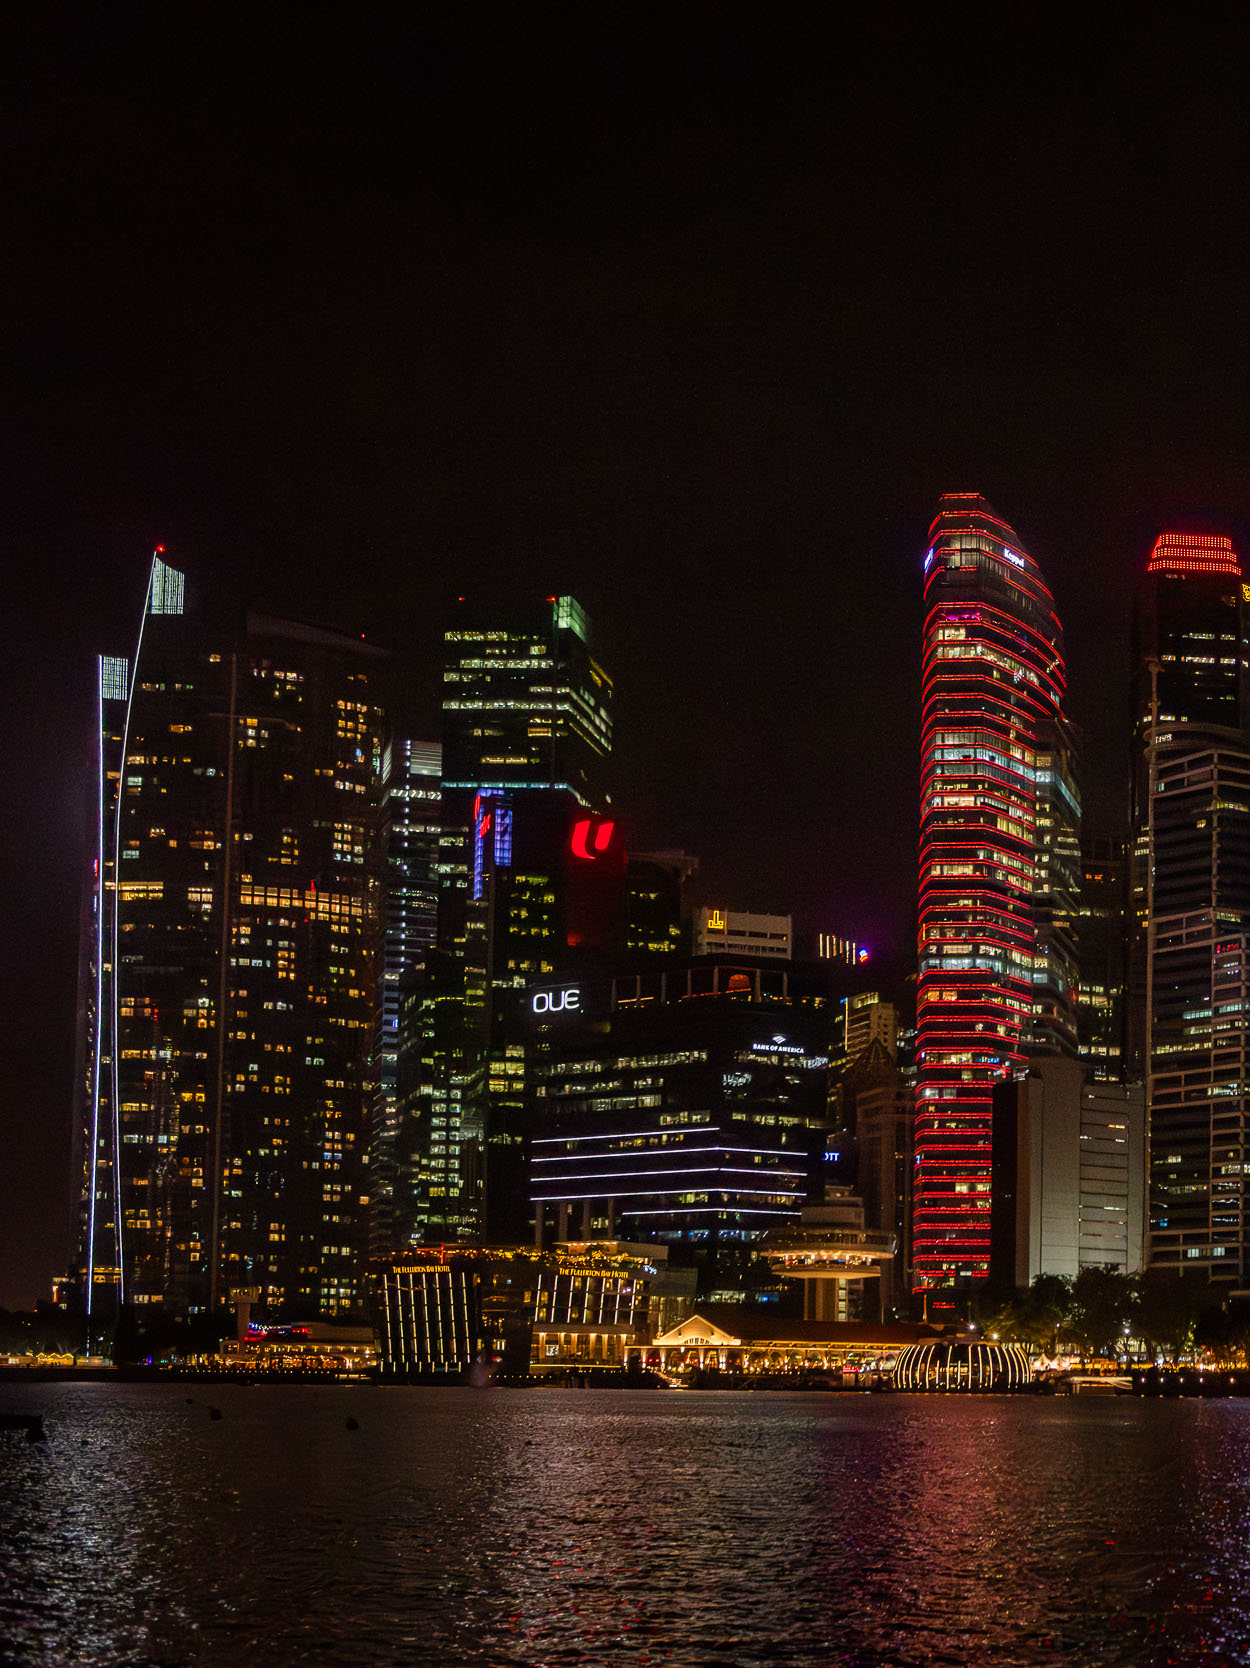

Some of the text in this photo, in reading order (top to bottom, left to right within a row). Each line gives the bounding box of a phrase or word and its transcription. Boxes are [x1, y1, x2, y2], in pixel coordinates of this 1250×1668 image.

[532, 989, 580, 1013] OUE
[752, 1043, 769, 1051] BANK
[778, 1046, 805, 1054] AMERICA
